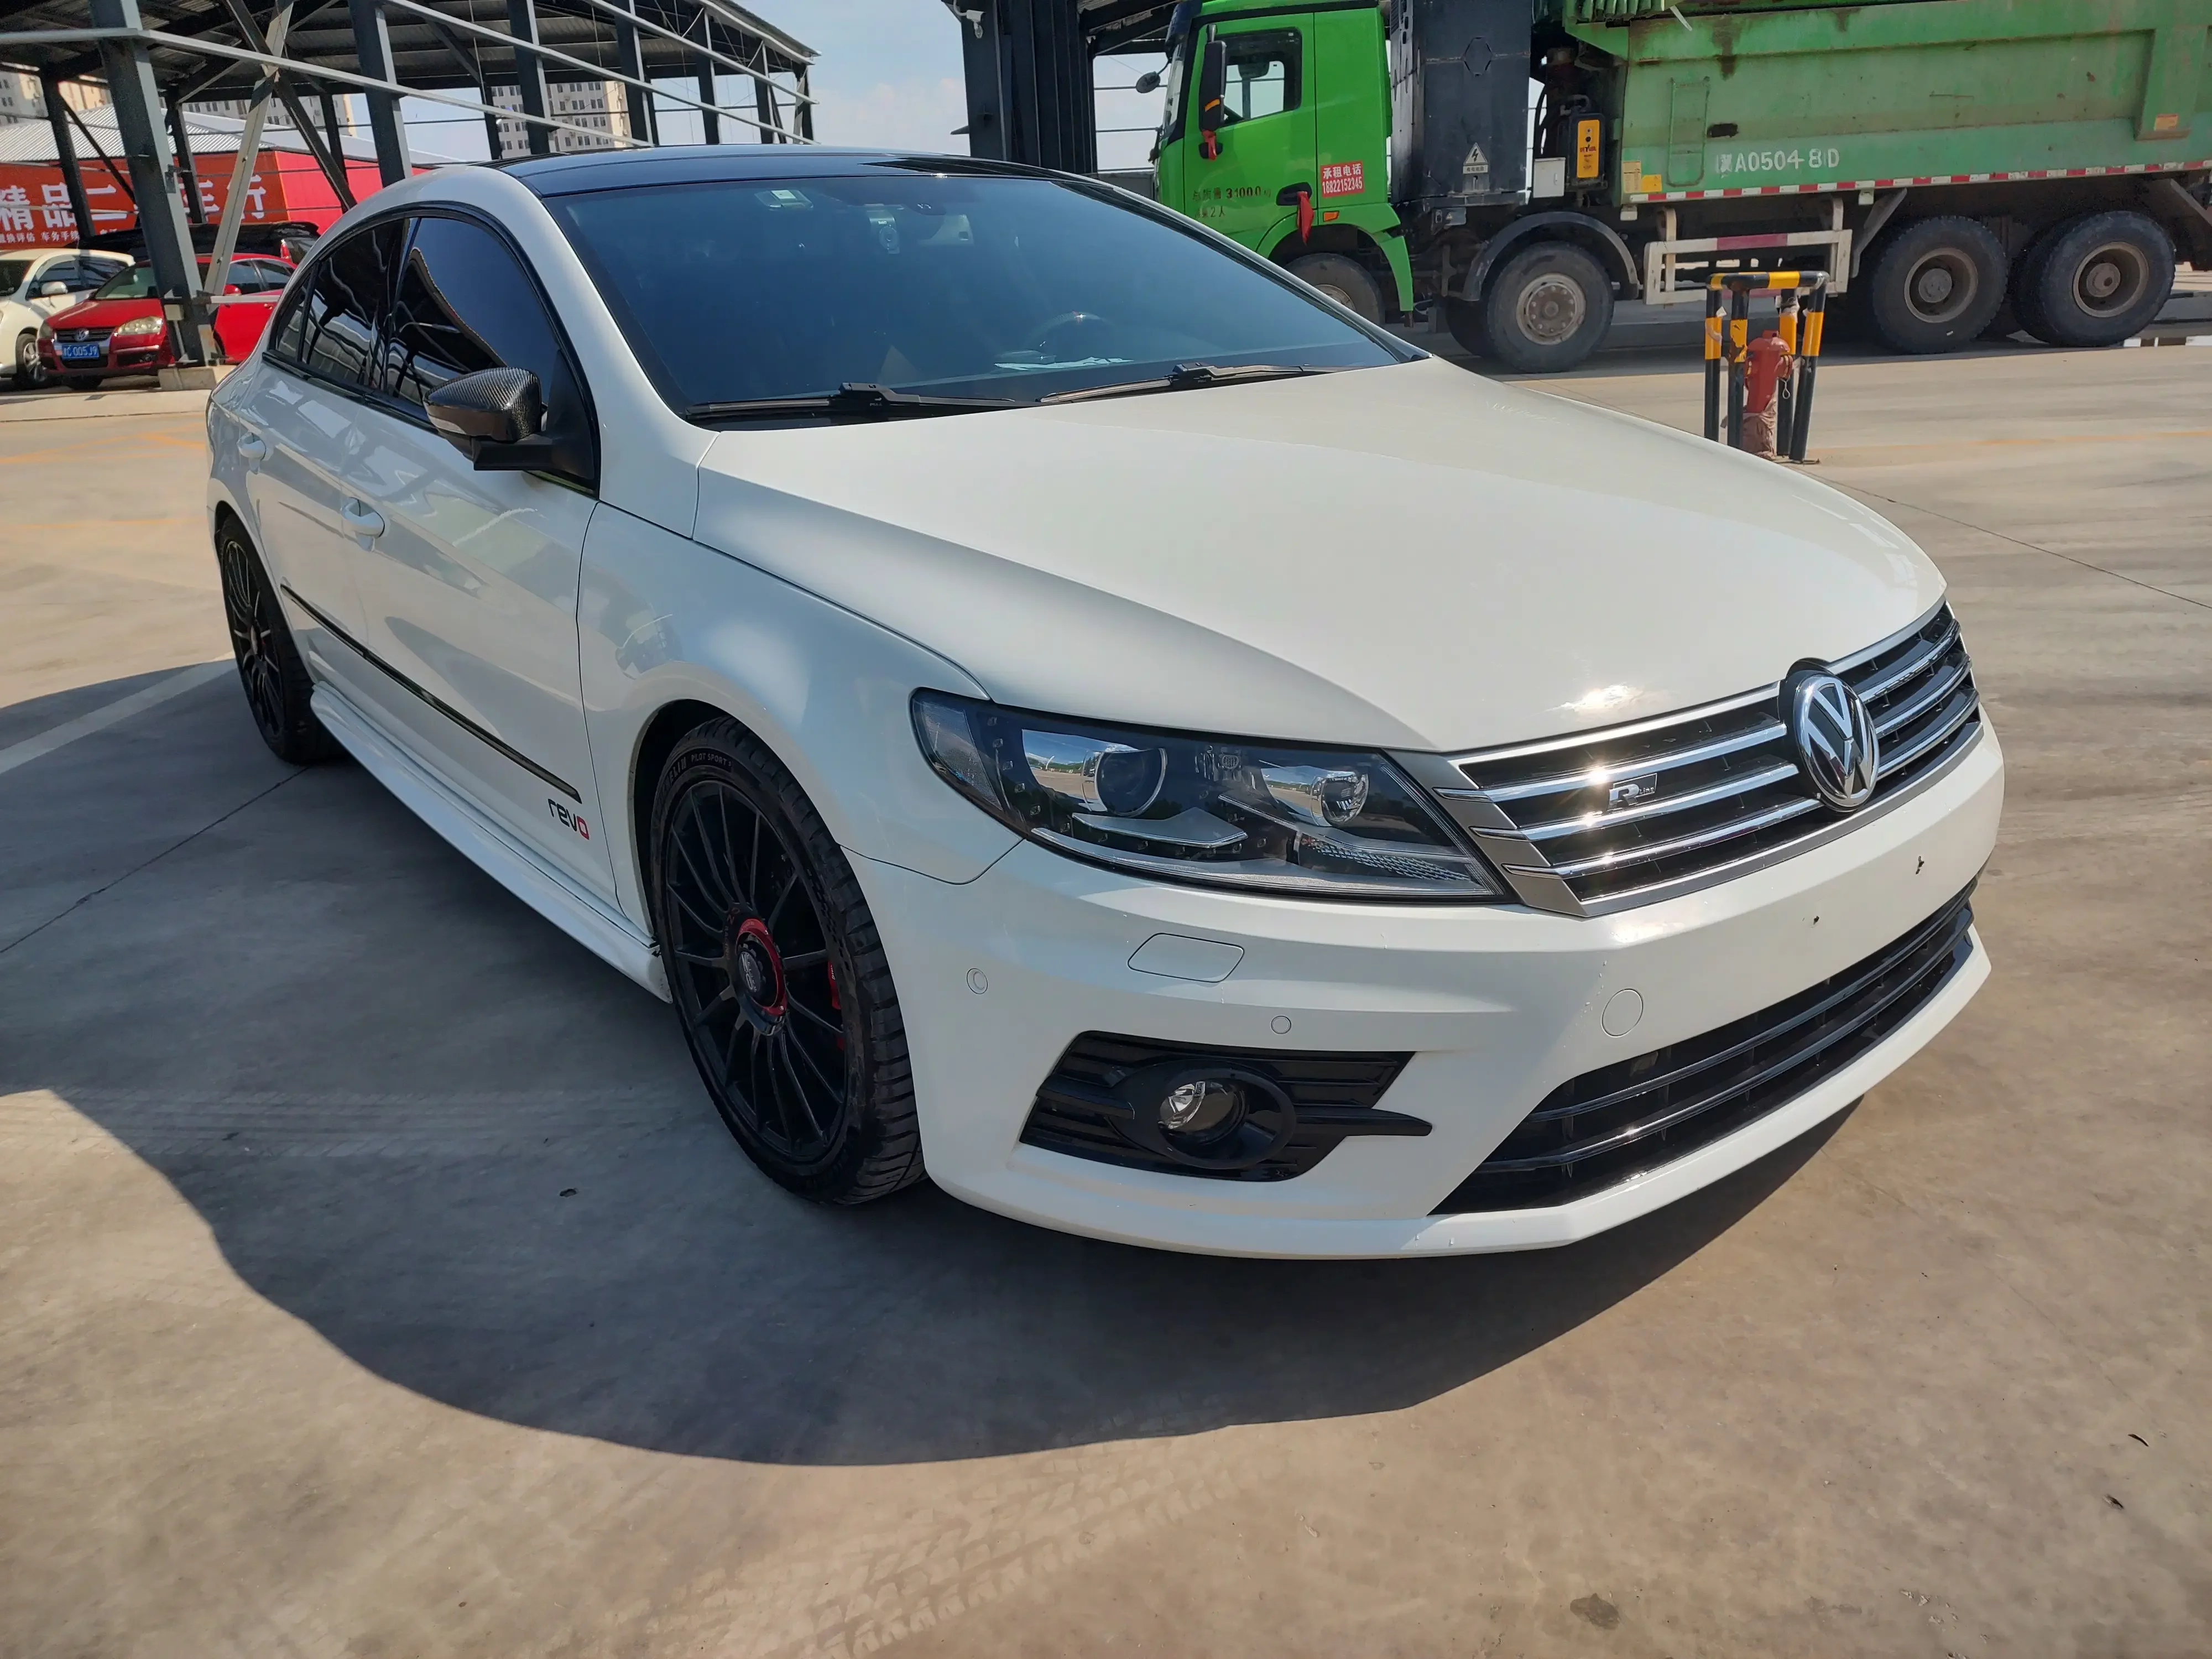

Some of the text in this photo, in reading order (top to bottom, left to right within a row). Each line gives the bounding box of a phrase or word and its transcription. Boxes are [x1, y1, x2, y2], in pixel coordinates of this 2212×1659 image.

[1323, 163, 1361, 180] 承租电话
[1322, 176, 1363, 194] 18822152345
[691, 753, 706, 763] PILOT
[707, 753, 727, 766] SPORT
